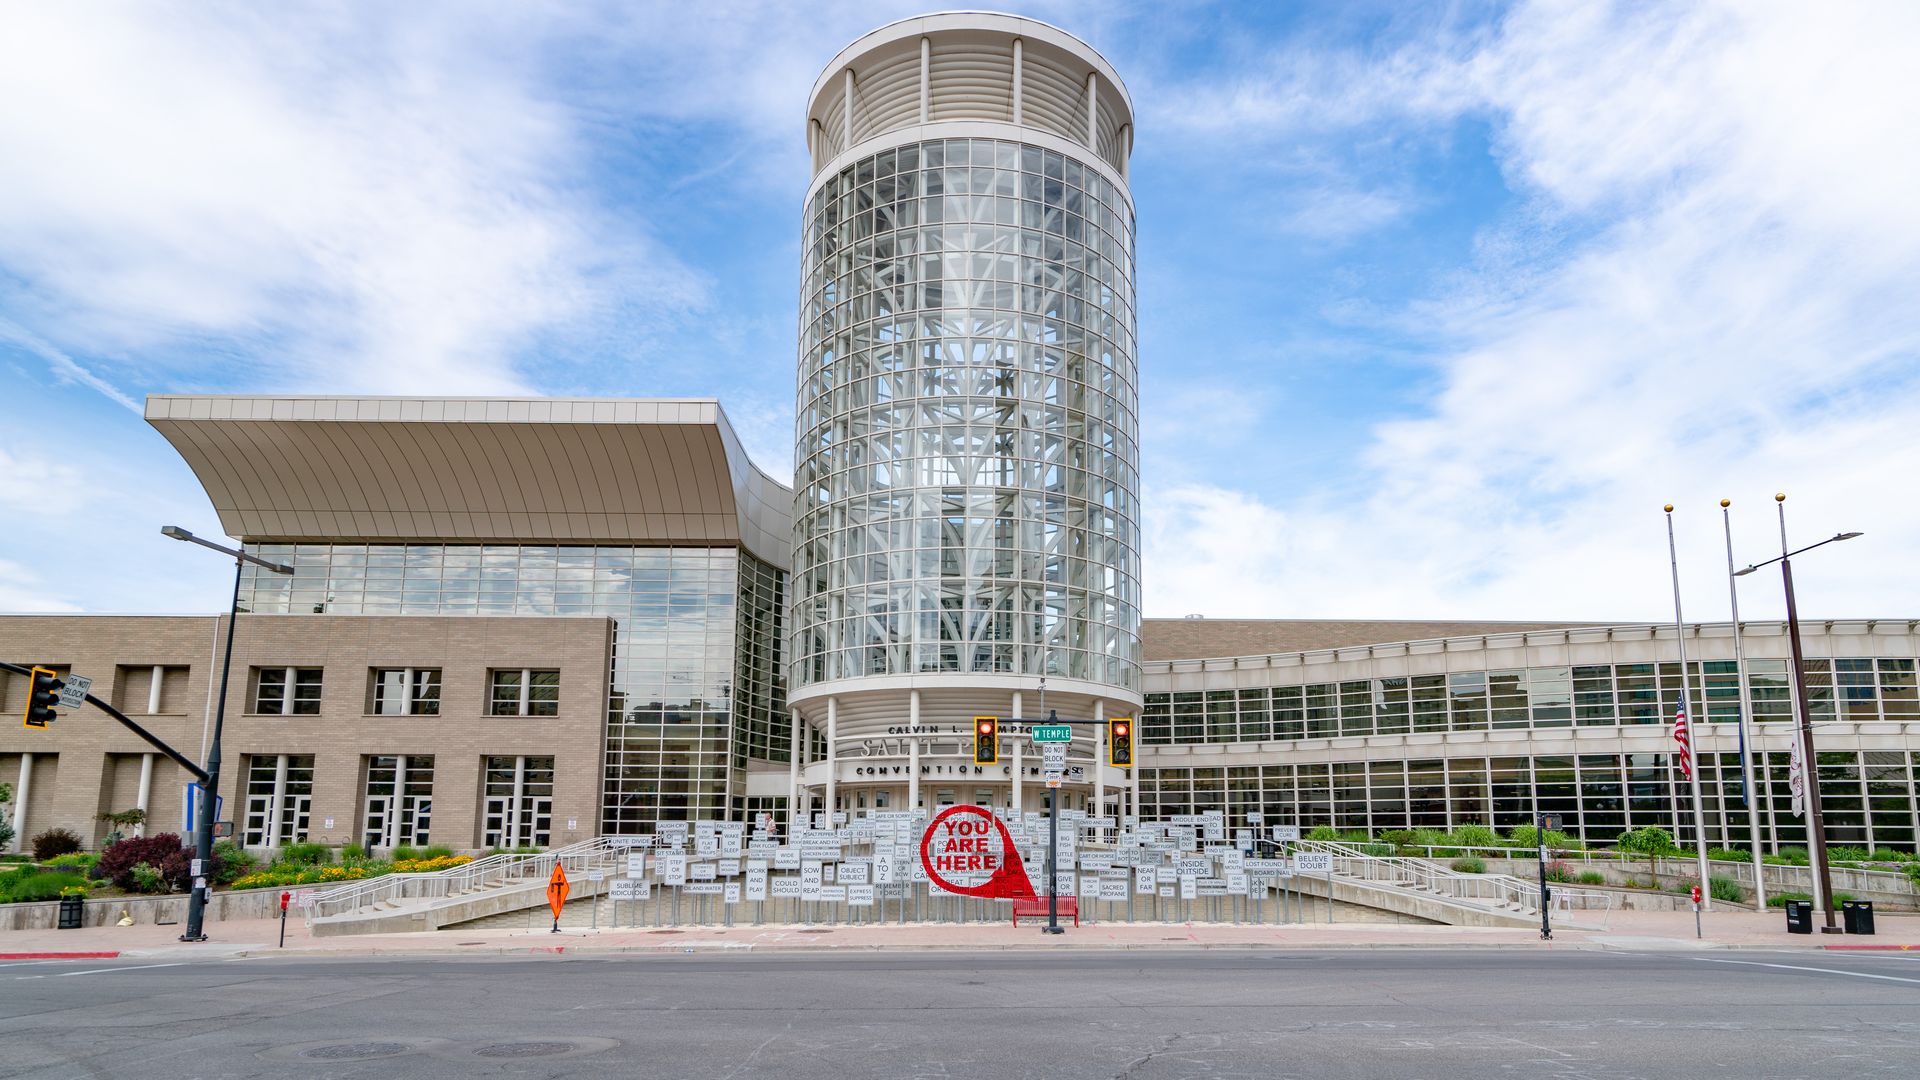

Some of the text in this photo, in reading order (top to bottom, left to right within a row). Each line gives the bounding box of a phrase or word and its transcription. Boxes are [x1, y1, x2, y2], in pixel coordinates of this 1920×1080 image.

[68, 677, 89, 689] DO NOT
[64, 688, 84, 698] BLOCK
[888, 726, 938, 734] CALVIN
[1034, 730, 1070, 738] W TEMPLE
[860, 737, 938, 757] SALT
[856, 766, 983, 776] CONVENTION
[944, 821, 988, 836] YOU
[944, 838, 988, 853] ARE
[937, 856, 997, 870] HERE
